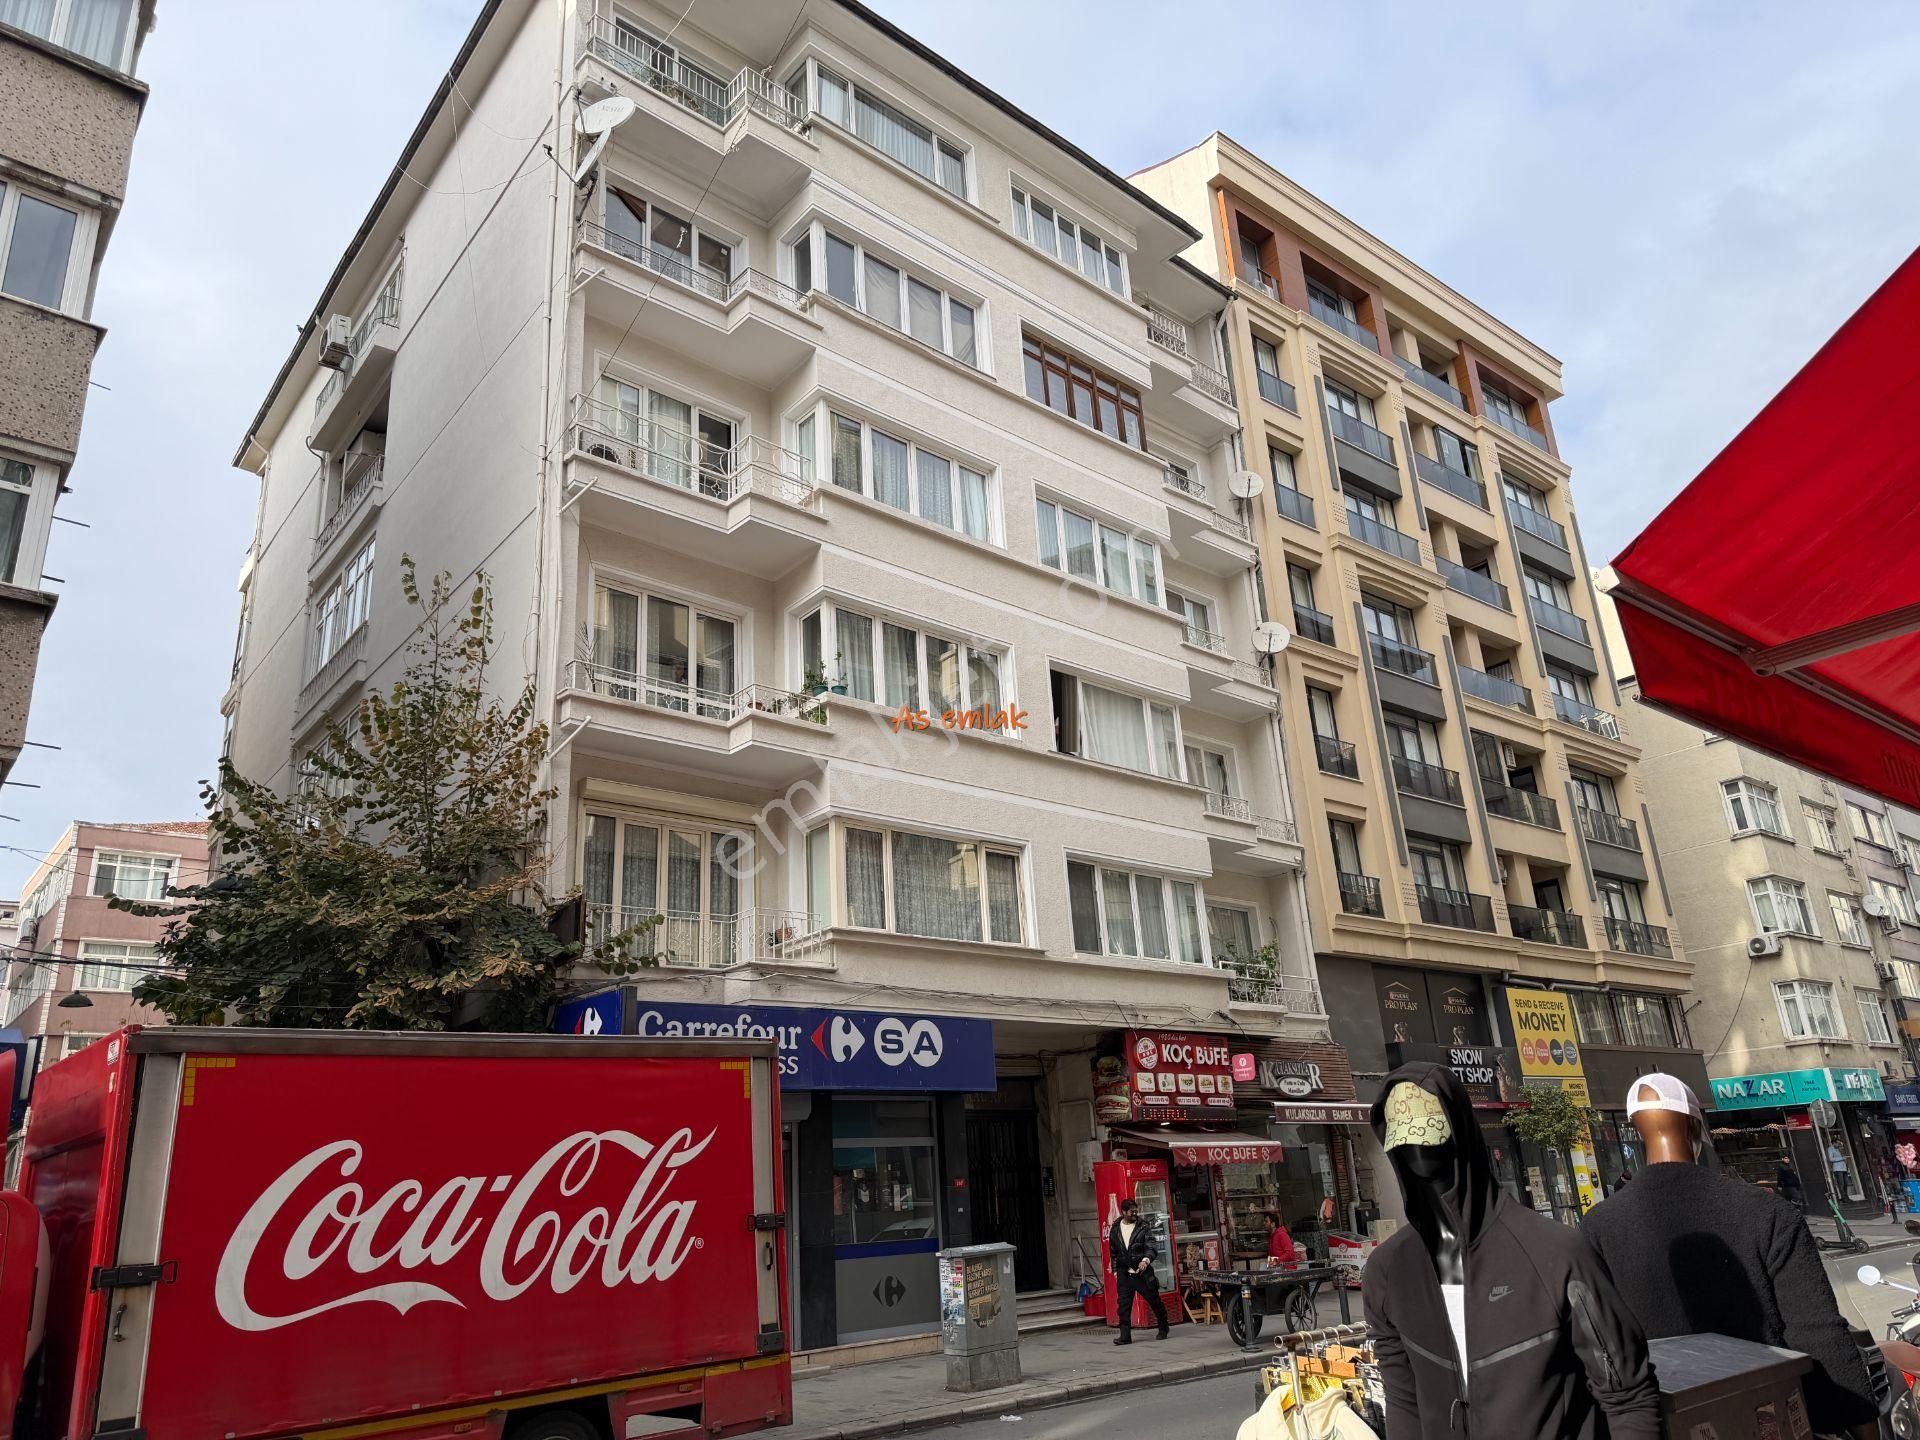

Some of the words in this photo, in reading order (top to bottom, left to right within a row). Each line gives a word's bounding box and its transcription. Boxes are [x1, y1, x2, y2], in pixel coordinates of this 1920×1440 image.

[1515, 999, 1532, 1008] SEND
[1533, 1000, 1538, 1008] &
[1539, 1000, 1565, 1010] RECEIVE
[1517, 1011, 1566, 1032] MONEY
[1161, 1043, 1193, 1069] KOÇ
[1195, 1046, 1230, 1066] BÜFE
[1450, 1048, 1483, 1065] SNOW
[1466, 1067, 1494, 1084] SHOP
[1717, 1079, 1787, 1099] NAZAR
[1332, 1109, 1353, 1120] EKMEK
[1208, 1148, 1230, 1163] KOÇ
[1233, 1147, 1258, 1160] BÜFE
[215, 1124, 718, 1331] Coca-Cola
